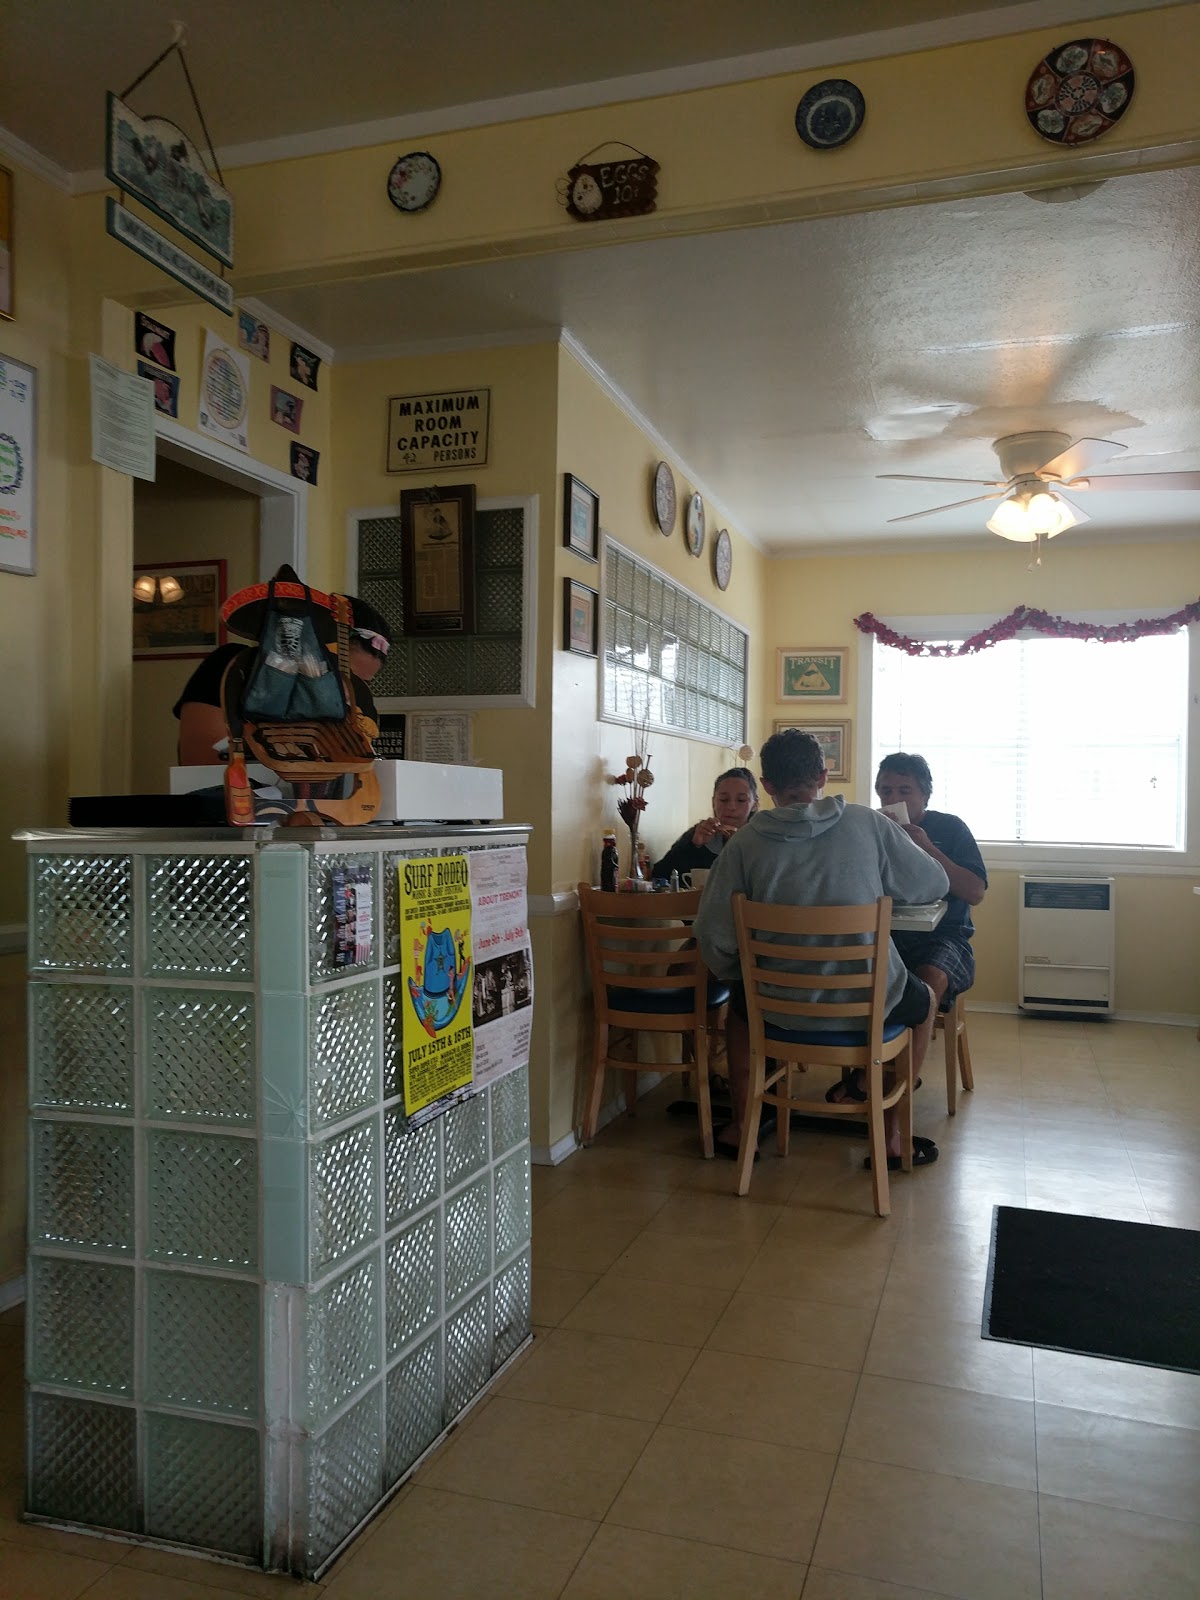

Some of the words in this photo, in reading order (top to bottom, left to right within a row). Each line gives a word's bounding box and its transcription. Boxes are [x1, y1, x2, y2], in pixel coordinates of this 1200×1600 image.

[600, 162, 649, 188] EGGS
[119, 210, 230, 304] WELCOME
[399, 395, 480, 417] MAXIMUM
[414, 415, 462, 433] ROOM
[397, 430, 479, 451] CAPACITY
[402, 452, 417, 465] 42
[433, 447, 477, 462] PERSONS
[788, 656, 837, 669] TRANSIT
[371, 738, 402, 747] TAILER
[404, 863, 435, 896] SURF
[437, 858, 468, 888] RODEO
[477, 893, 498, 907] ABOUT
[499, 889, 523, 903] TREMONT
[478, 937, 491, 950] June
[491, 933, 500, 946] 9th
[504, 929, 515, 943] July
[408, 1045, 427, 1068] JULY
[428, 1036, 446, 1055] 15TH
[447, 1034, 453, 1047] &
[454, 1025, 472, 1045] 16TH
